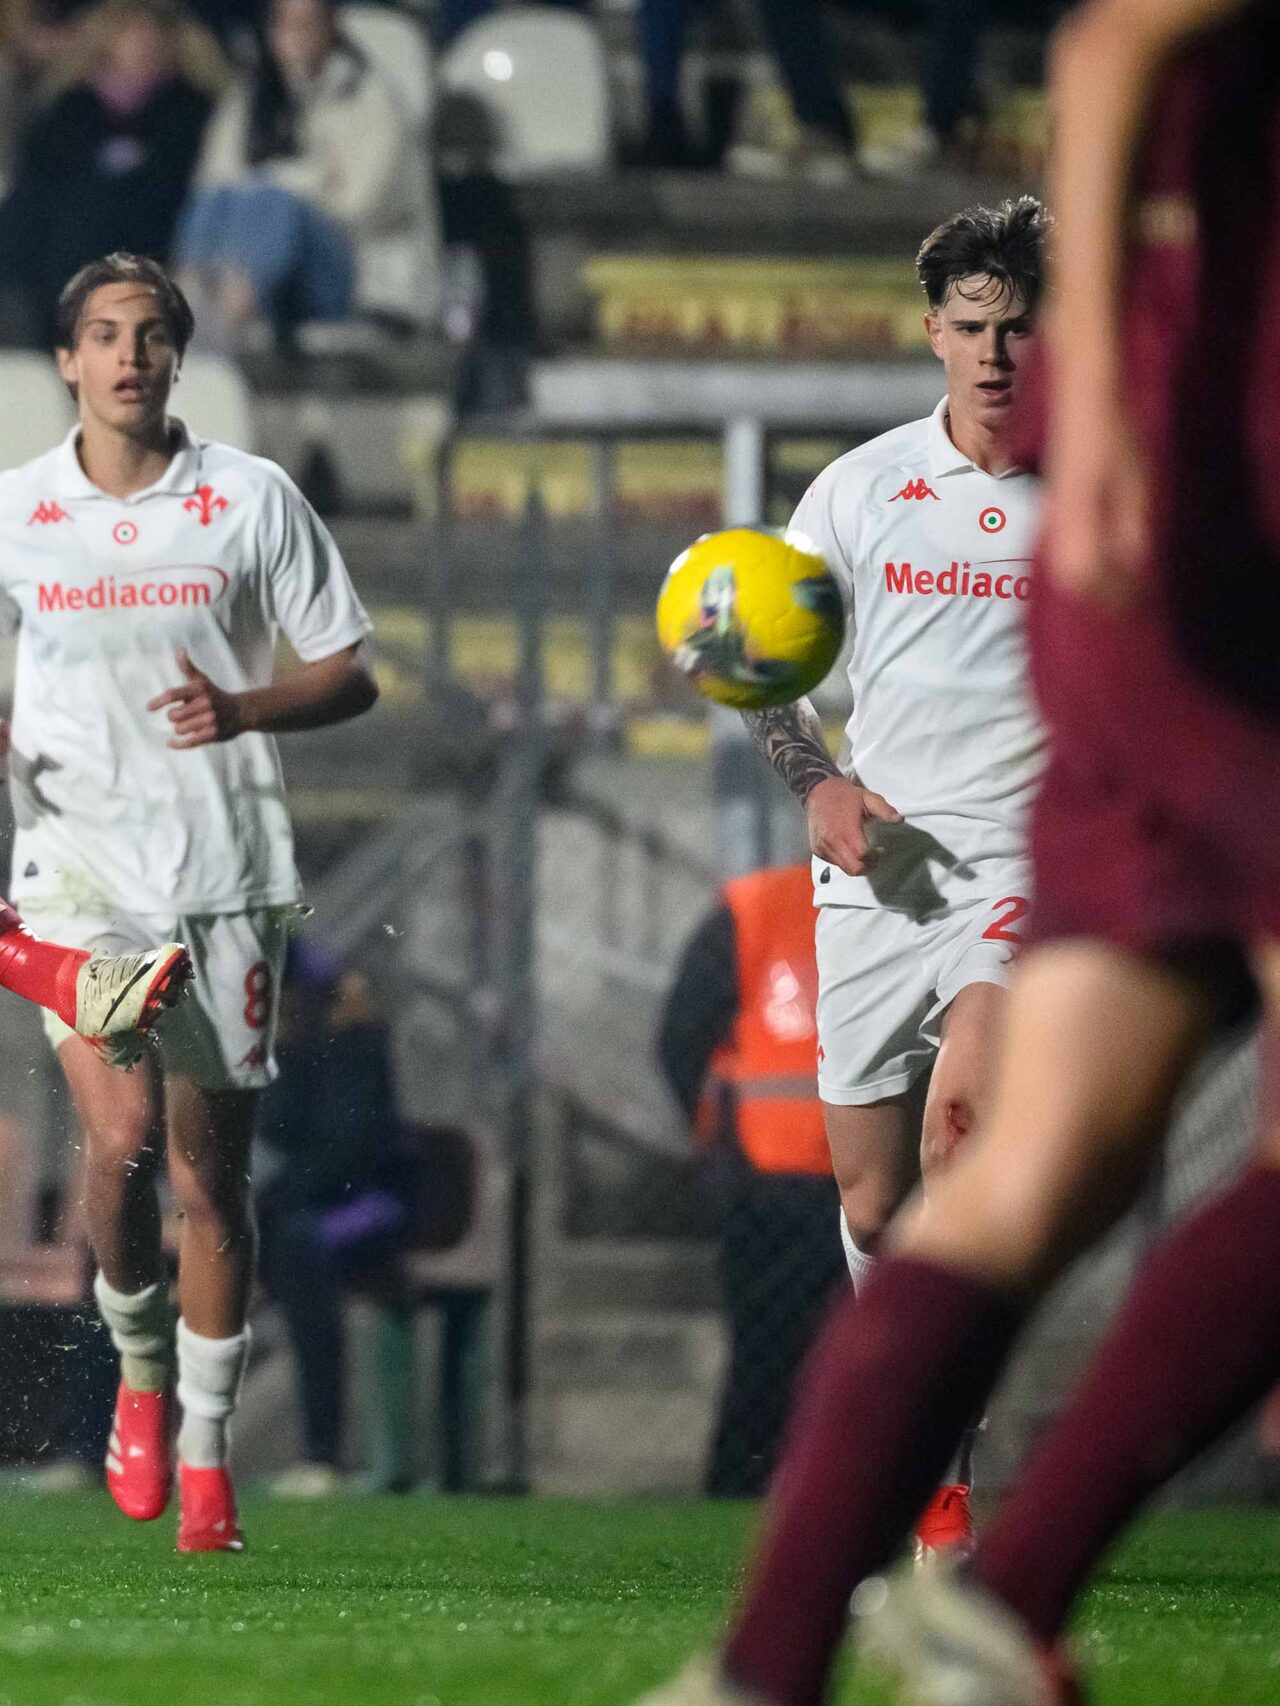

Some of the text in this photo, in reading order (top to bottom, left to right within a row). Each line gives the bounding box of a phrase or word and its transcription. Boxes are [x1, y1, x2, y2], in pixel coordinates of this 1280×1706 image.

[37, 575, 211, 611] Mediacom
[884, 561, 1030, 600] Mediaco
[981, 896, 1026, 944] 2
[244, 961, 271, 1028] 8
